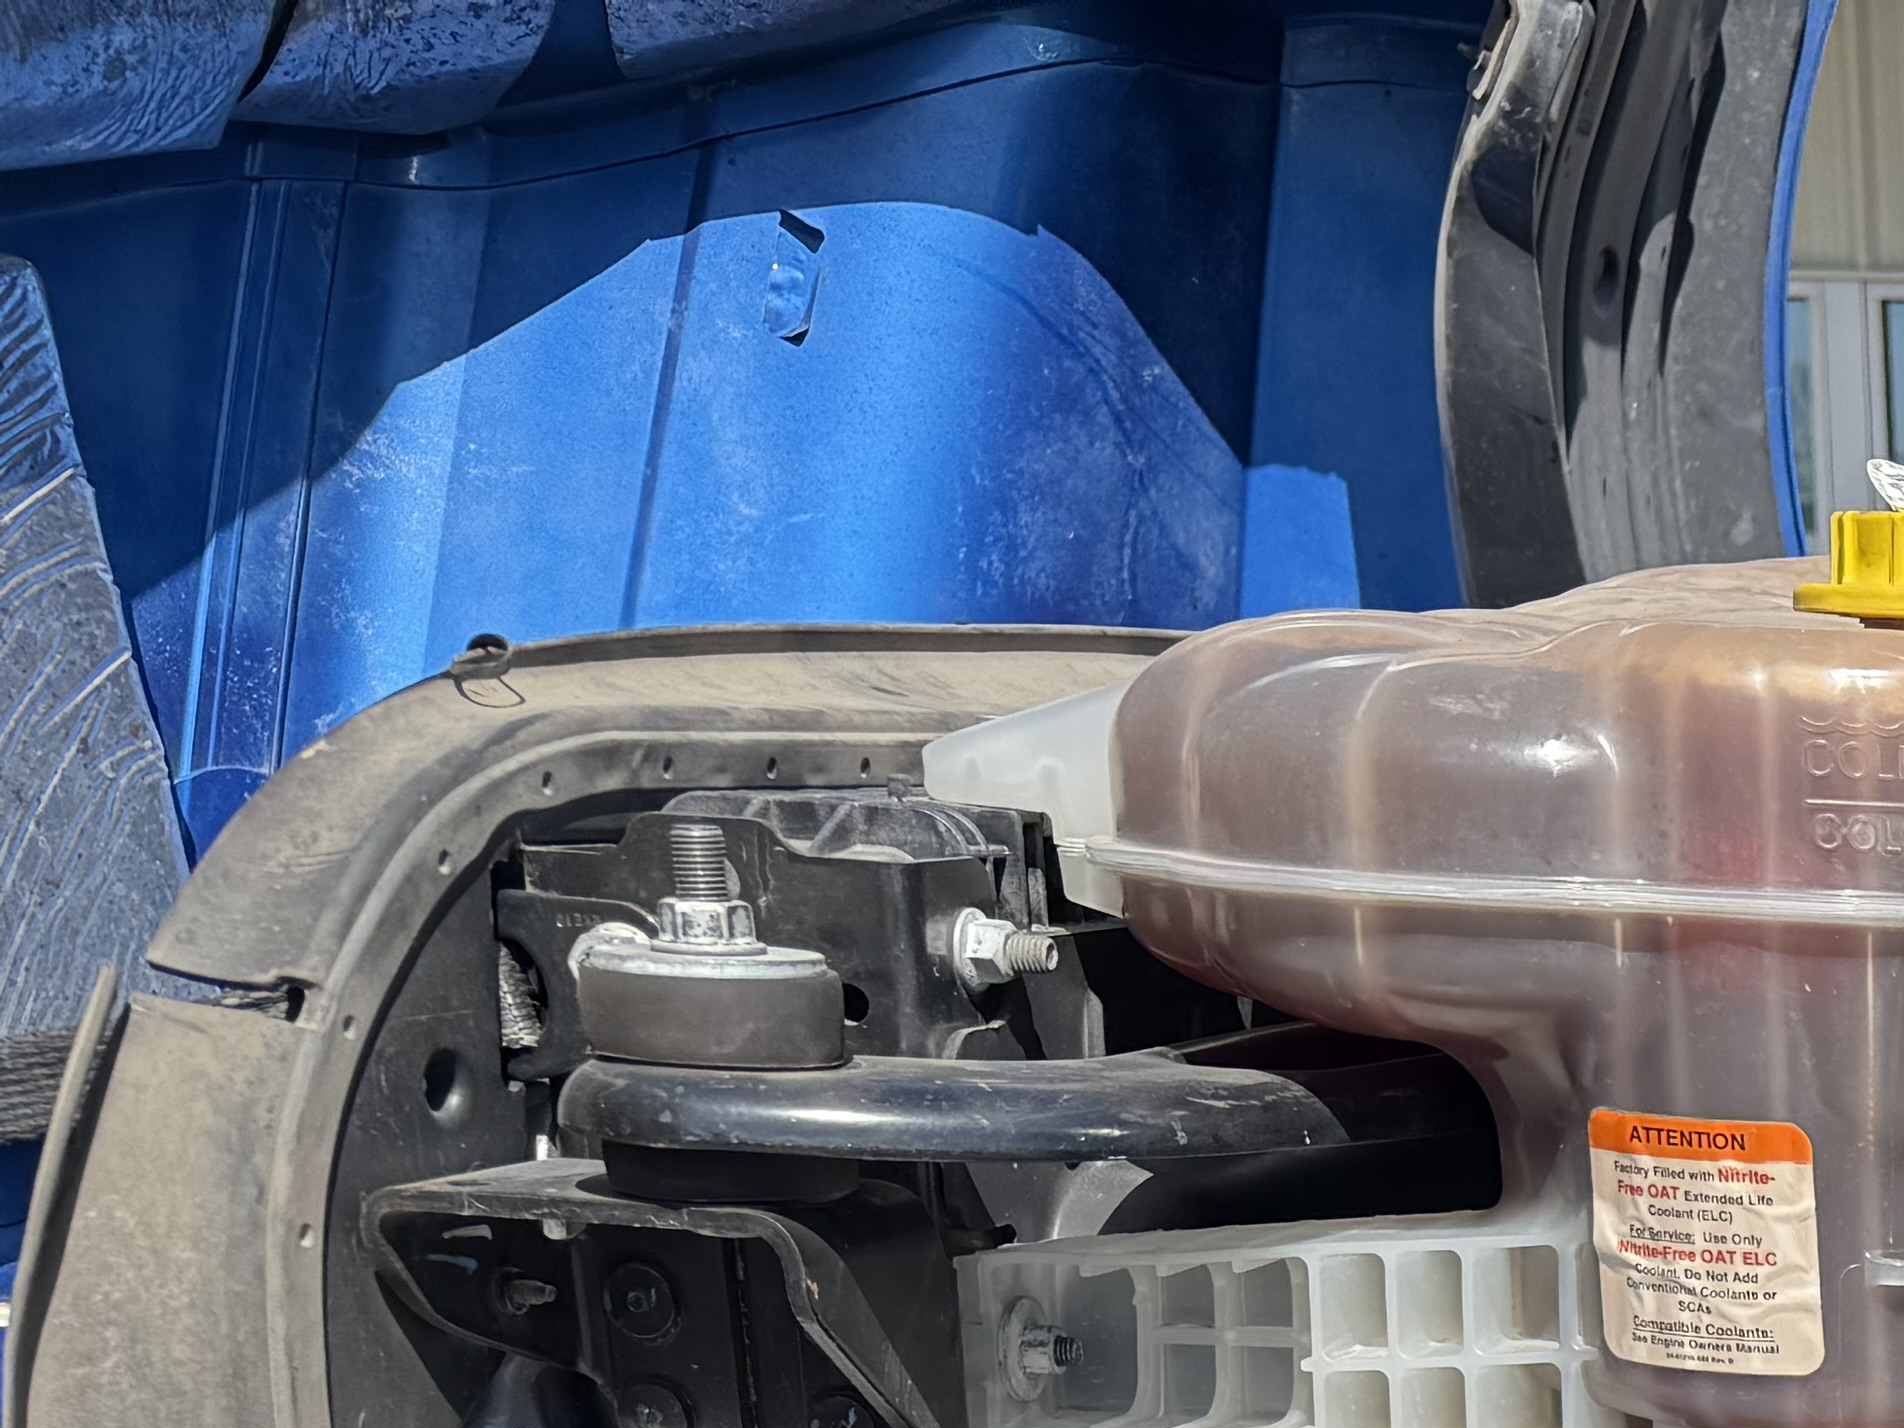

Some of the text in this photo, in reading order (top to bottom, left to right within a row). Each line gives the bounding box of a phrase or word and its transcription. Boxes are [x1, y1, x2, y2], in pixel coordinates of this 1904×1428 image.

[1629, 1125, 1747, 1151] ATTENTION
[1614, 1160, 1776, 1185] Factory Filled with Nitrite-
[1618, 1180, 1773, 1207] Free OAT Extended Life
[1648, 1205, 1733, 1225] Coolant (ELC)
[1629, 1224, 1647, 1237] For
[1703, 1231, 1727, 1245] Use
[1732, 1233, 1763, 1251] Only
[1618, 1239, 1778, 1267] Nitrite-Free OAT ELC
[1626, 1277, 1778, 1301] Conventional Coolants or
[1684, 1268, 1701, 1282] Do
[1706, 1270, 1729, 1283] Not
[1732, 1271, 1759, 1285] Add
[1678, 1300, 1712, 1315] SCAs
[1633, 1315, 1774, 1340] Compatible Coolants:
[1650, 1335, 1685, 1349] Engine
[1736, 1342, 1779, 1355] Manual
